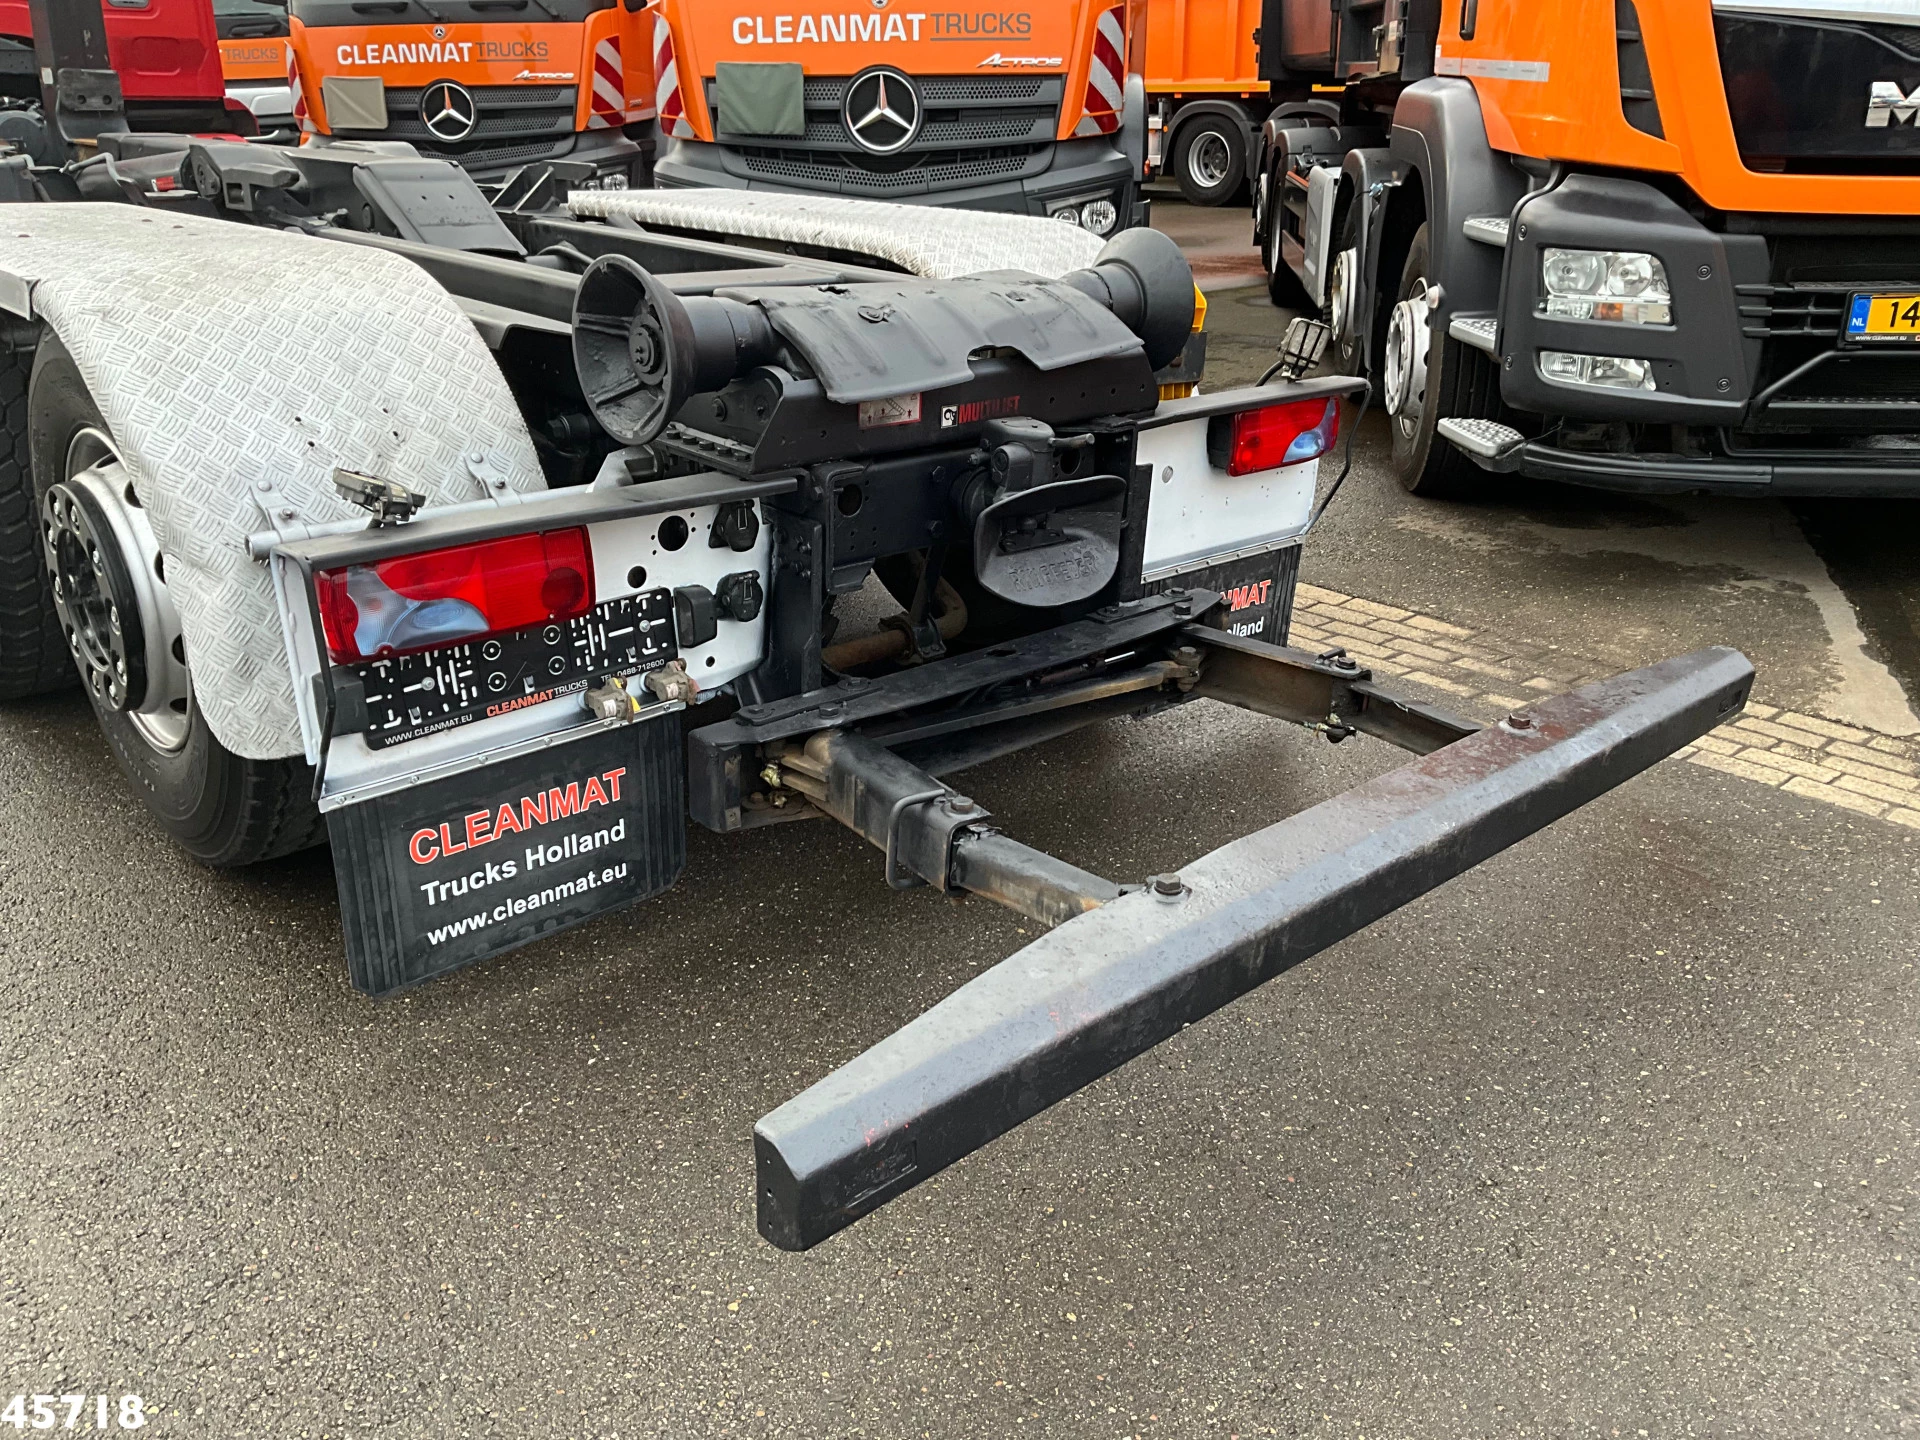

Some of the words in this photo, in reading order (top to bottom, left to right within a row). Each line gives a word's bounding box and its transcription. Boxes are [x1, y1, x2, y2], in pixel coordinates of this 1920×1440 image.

[732, 13, 926, 45] CLEANMAT
[930, 12, 1032, 34] TRUCKS
[224, 47, 279, 60] TRUCKS
[337, 42, 472, 65] CLEANMAT
[476, 41, 549, 57] TRUCKS
[1851, 317, 1865, 327] NL
[486, 689, 555, 718] CLEANMAT
[554, 678, 589, 696] TRUCKS
[384, 713, 474, 745] WWW.CLEANMAT.EU
[408, 767, 627, 865] CLEANMAT
[420, 859, 518, 906] Trucks
[525, 818, 626, 871] Holland
[427, 863, 628, 946] www.cleanmat.eu
